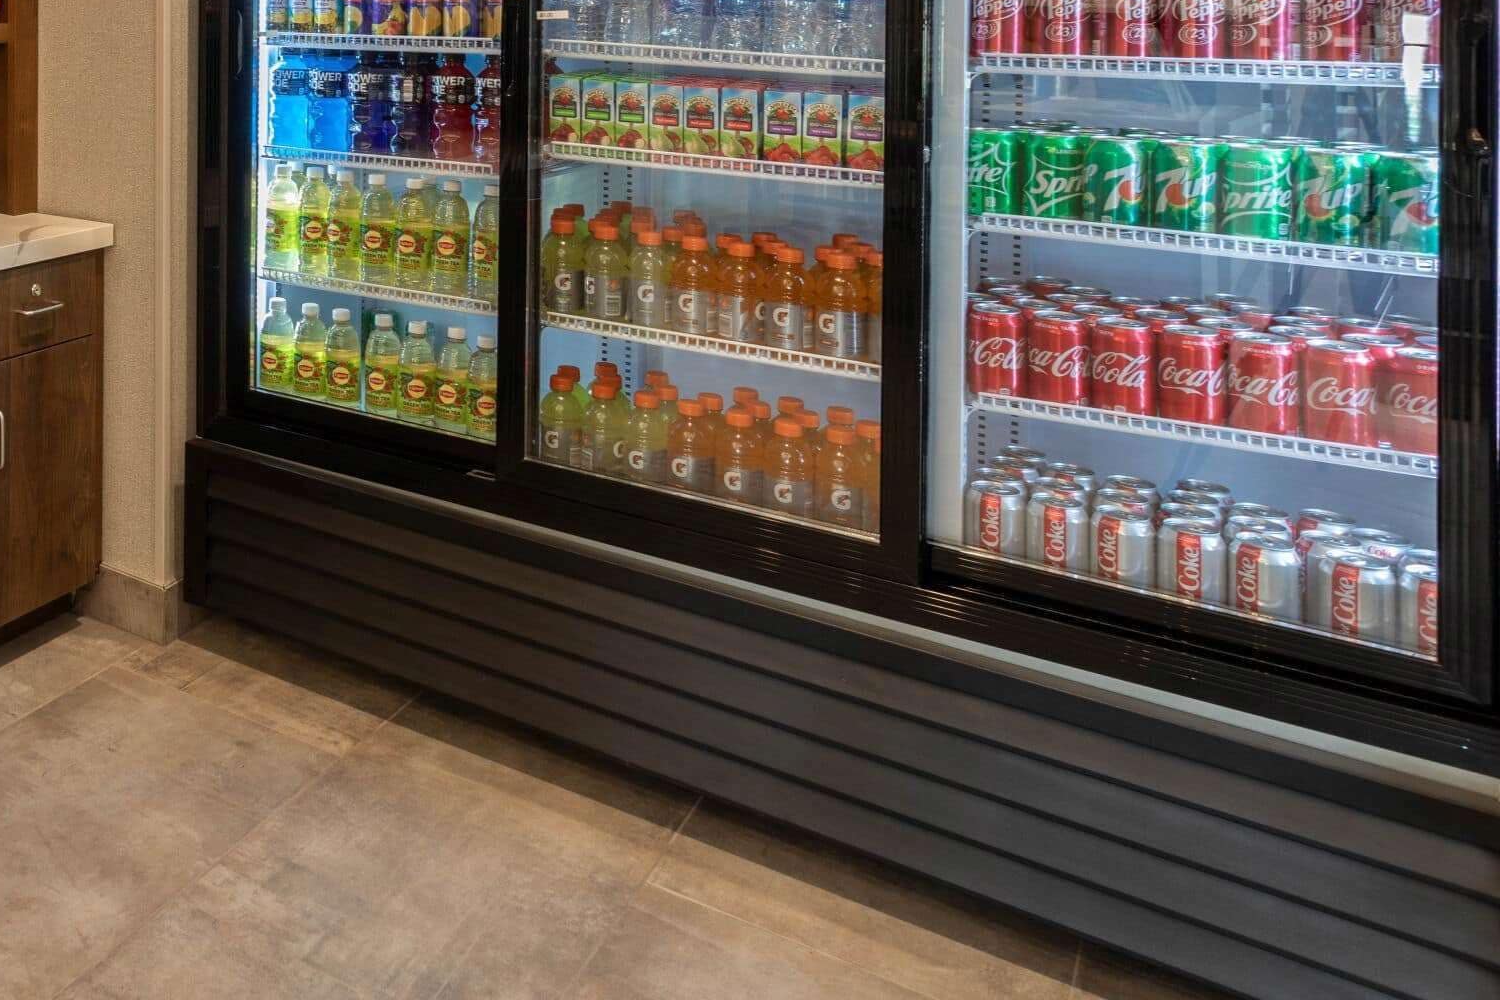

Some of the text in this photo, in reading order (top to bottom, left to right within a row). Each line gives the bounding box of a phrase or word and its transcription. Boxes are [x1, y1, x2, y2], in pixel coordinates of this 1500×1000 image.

[1053, 25, 1071, 37] 23
[1190, 28, 1206, 39] 23
[818, 313, 836, 334] G
[981, 506, 1000, 548] Coke
[1046, 520, 1066, 563] Coke
[1098, 528, 1118, 574] Coke
[1178, 547, 1200, 592] Coke
[1237, 556, 1257, 603] Coke
[1334, 576, 1357, 627] Coke
